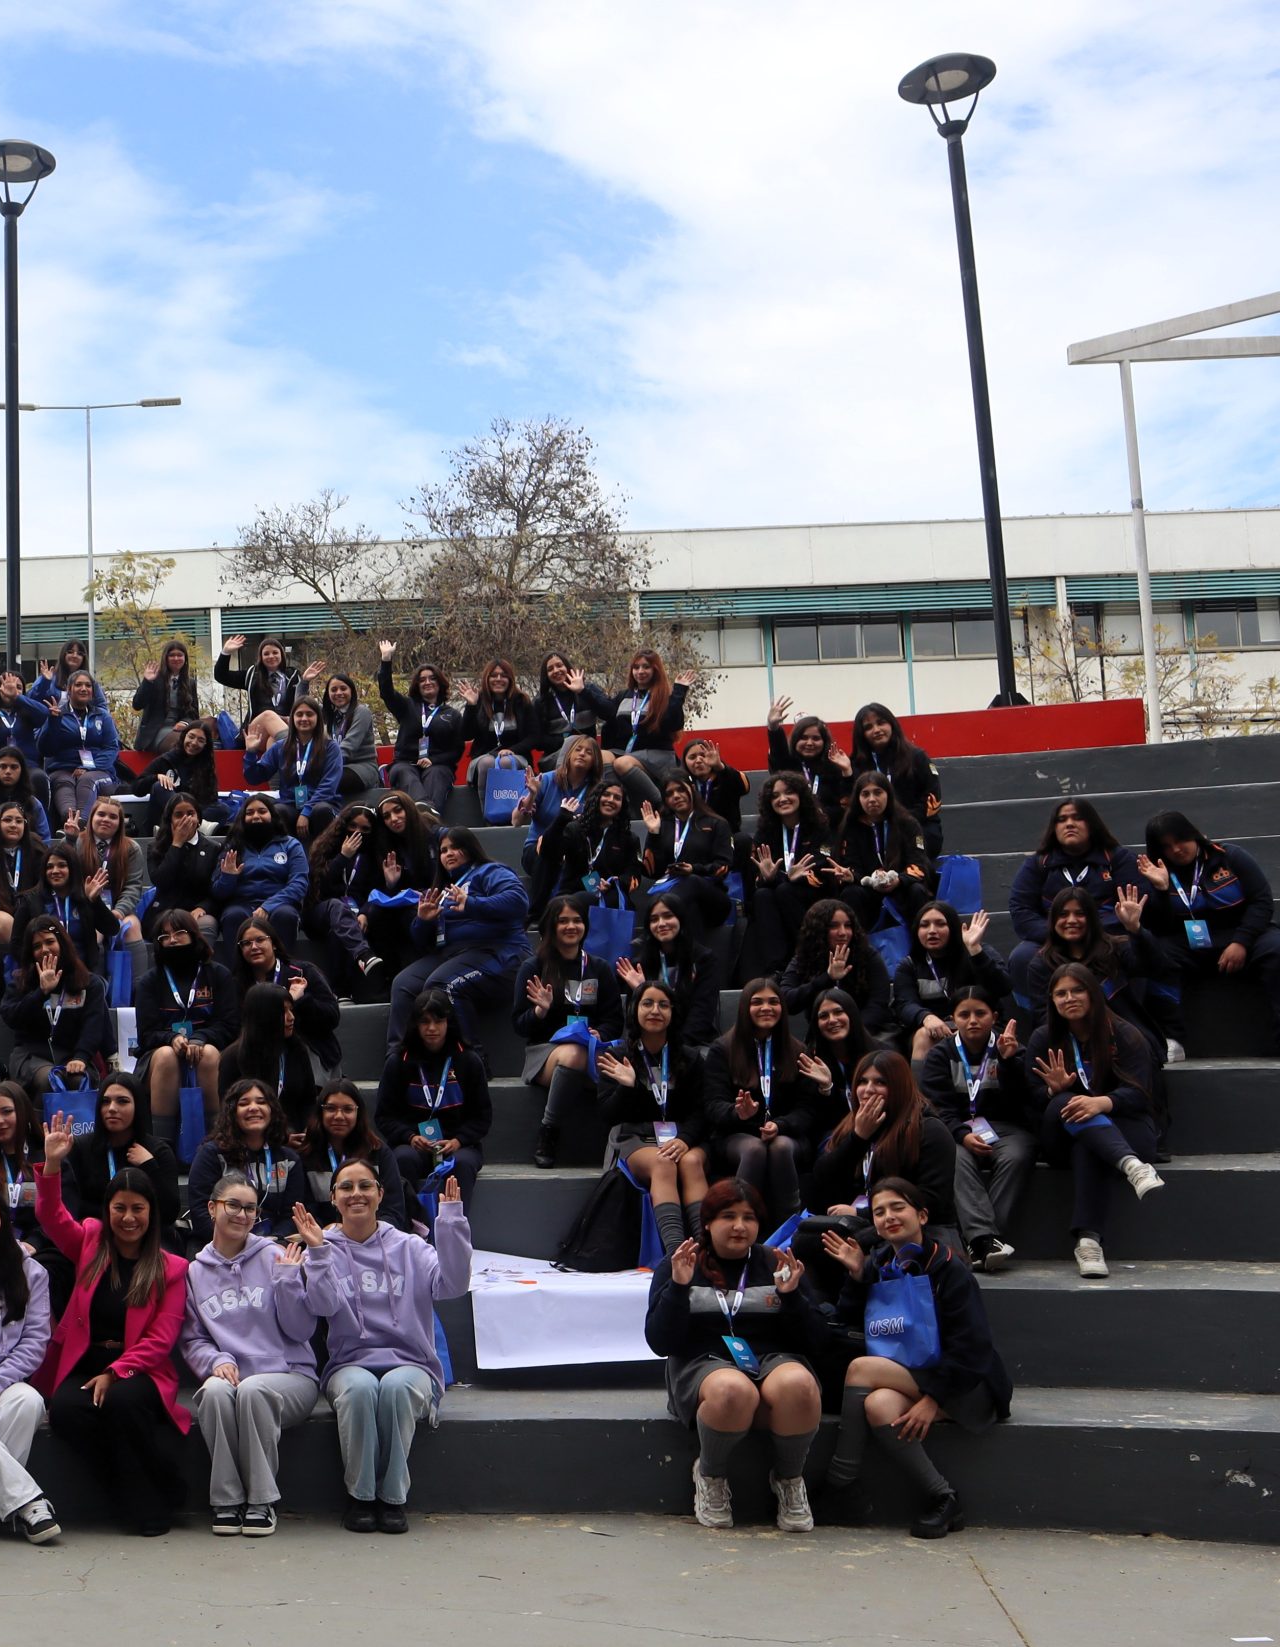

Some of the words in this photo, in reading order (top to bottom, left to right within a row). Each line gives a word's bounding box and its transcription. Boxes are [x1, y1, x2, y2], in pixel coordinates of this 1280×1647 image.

[493, 789, 519, 800] USM
[338, 1270, 405, 1298] USM
[201, 1285, 265, 1320] USM
[868, 1315, 905, 1338] USM
